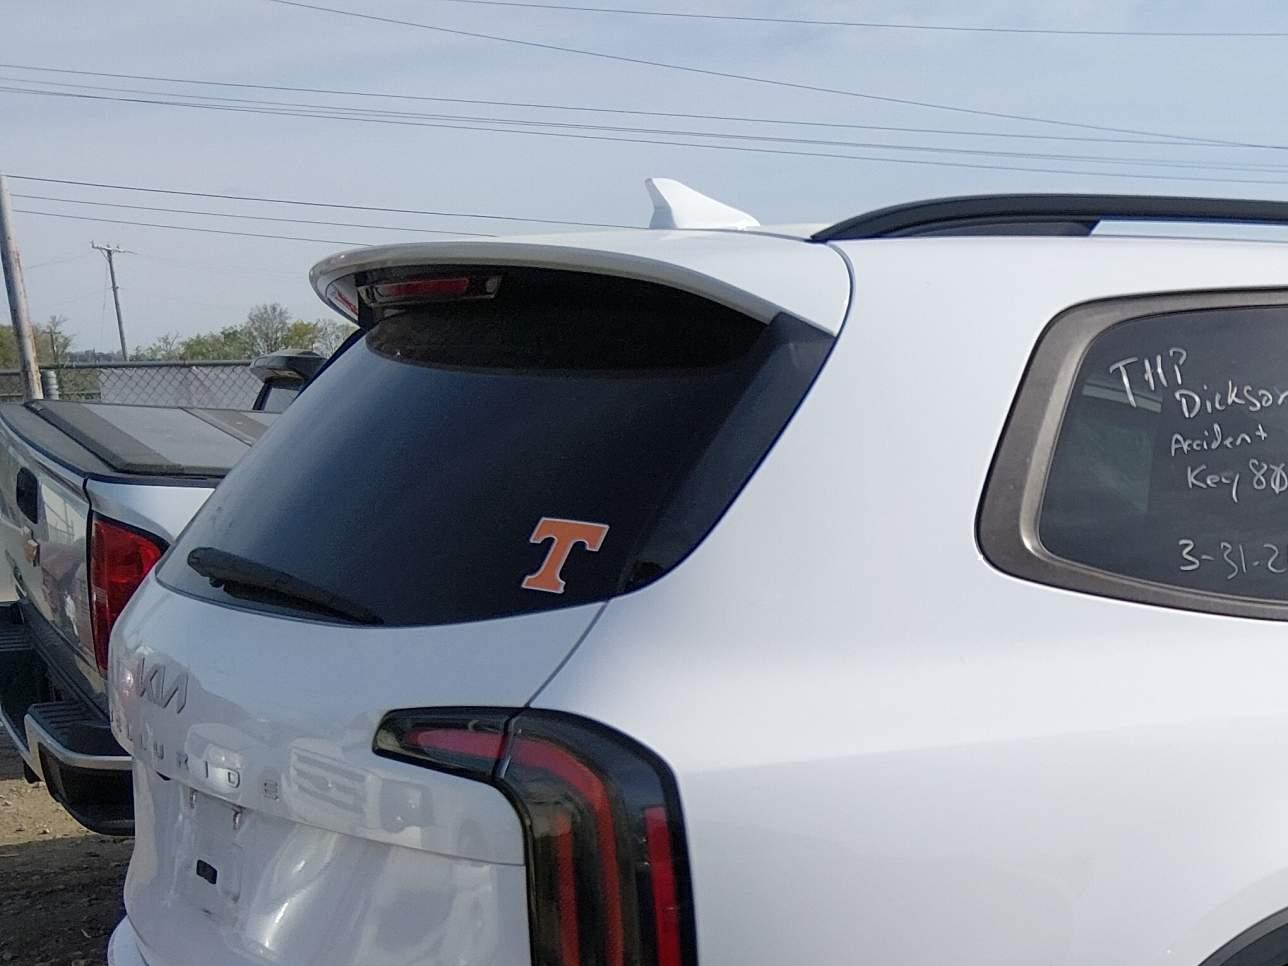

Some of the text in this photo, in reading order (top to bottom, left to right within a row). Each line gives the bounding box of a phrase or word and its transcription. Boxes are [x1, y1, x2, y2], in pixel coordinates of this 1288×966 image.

[1171, 423, 1268, 456] Accident
[1187, 465, 1240, 502] Key
[521, 517, 610, 594] T
